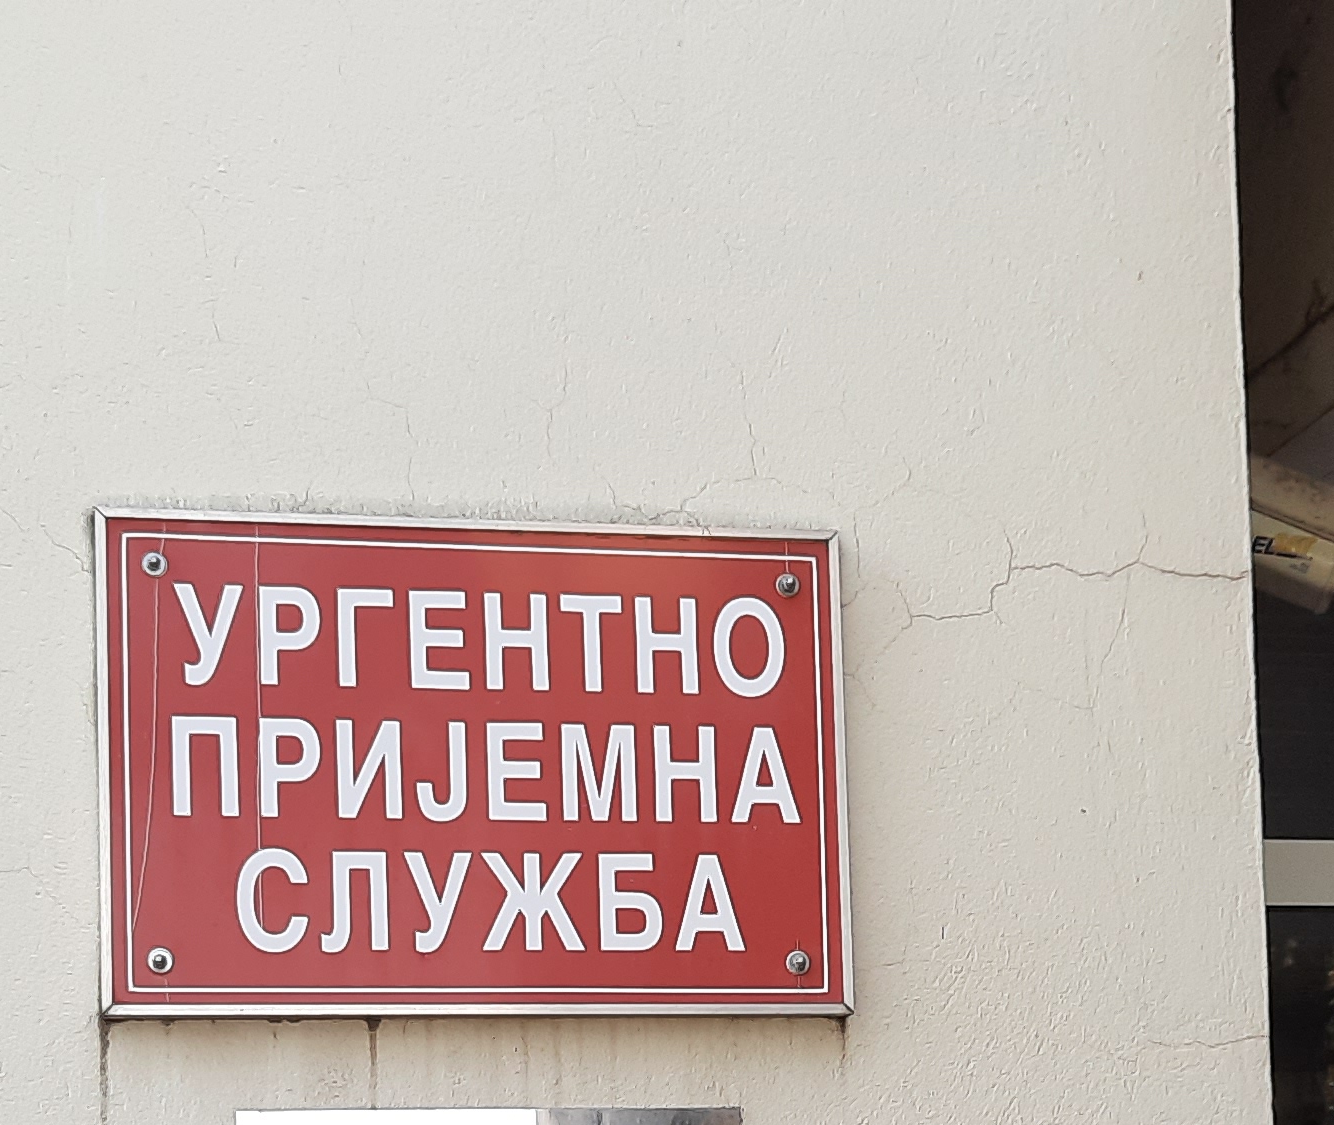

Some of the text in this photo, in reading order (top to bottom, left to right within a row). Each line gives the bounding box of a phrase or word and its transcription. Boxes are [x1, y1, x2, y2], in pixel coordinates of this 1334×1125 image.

[174, 582, 786, 698] УРГЕНТНО
[170, 715, 800, 824] ПРИЈЕМНА
[235, 847, 746, 954] СЛУЖБА
